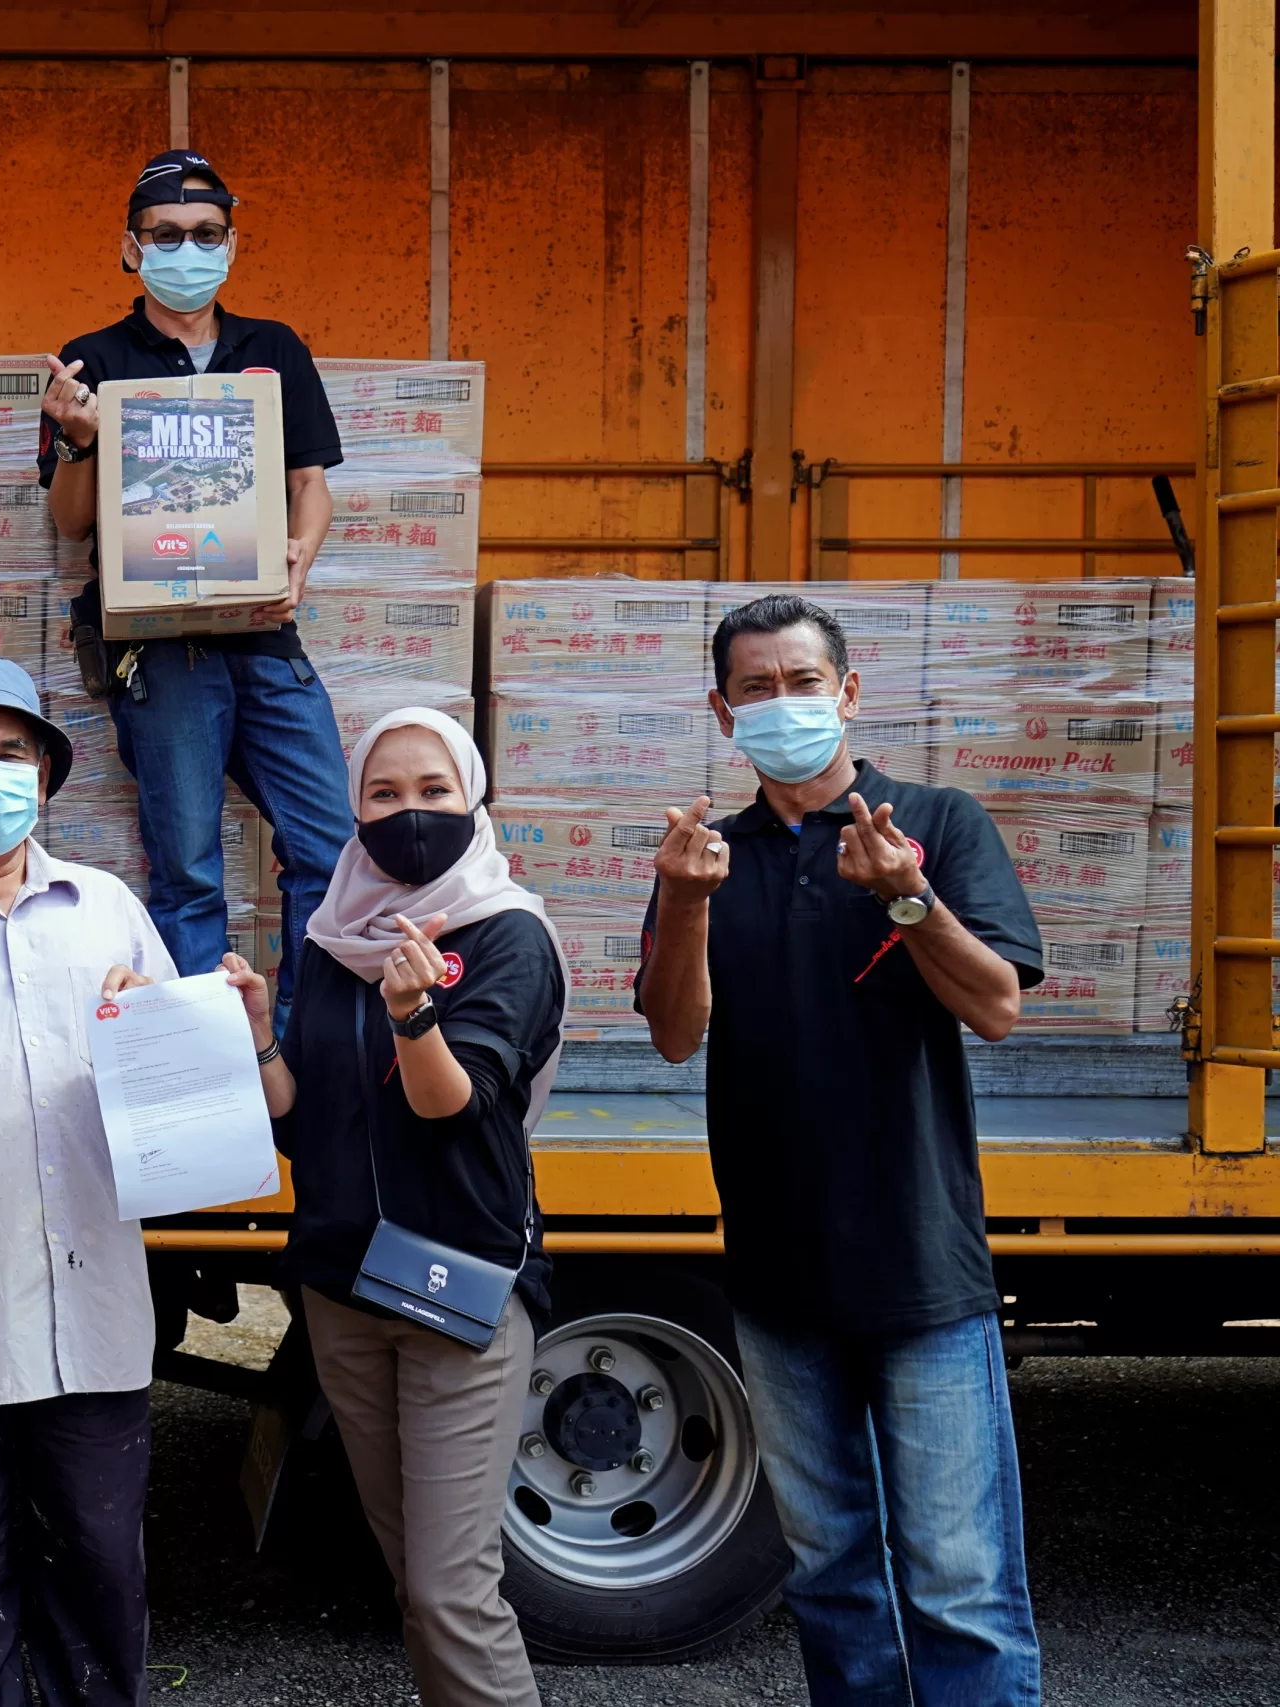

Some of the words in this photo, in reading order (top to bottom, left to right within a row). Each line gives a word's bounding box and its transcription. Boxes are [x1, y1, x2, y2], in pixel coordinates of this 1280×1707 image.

[152, 415, 224, 446] MISI
[138, 446, 194, 458] BANTUAN
[197, 446, 239, 458] BANJIR
[156, 540, 188, 550] Vit's
[504, 602, 547, 620] Vit's
[944, 603, 988, 623] Vit's
[848, 642, 881, 661] ack
[508, 713, 550, 732] Vit's
[953, 716, 997, 736] Vit's
[952, 748, 1056, 776] Economy
[1061, 751, 1117, 773] Pack
[501, 823, 544, 843] Vit's
[445, 960, 459, 975] t's
[100, 1006, 118, 1015] Vit's
[401, 1301, 414, 1310] KARL
[415, 1307, 445, 1323] LAGERFELD
